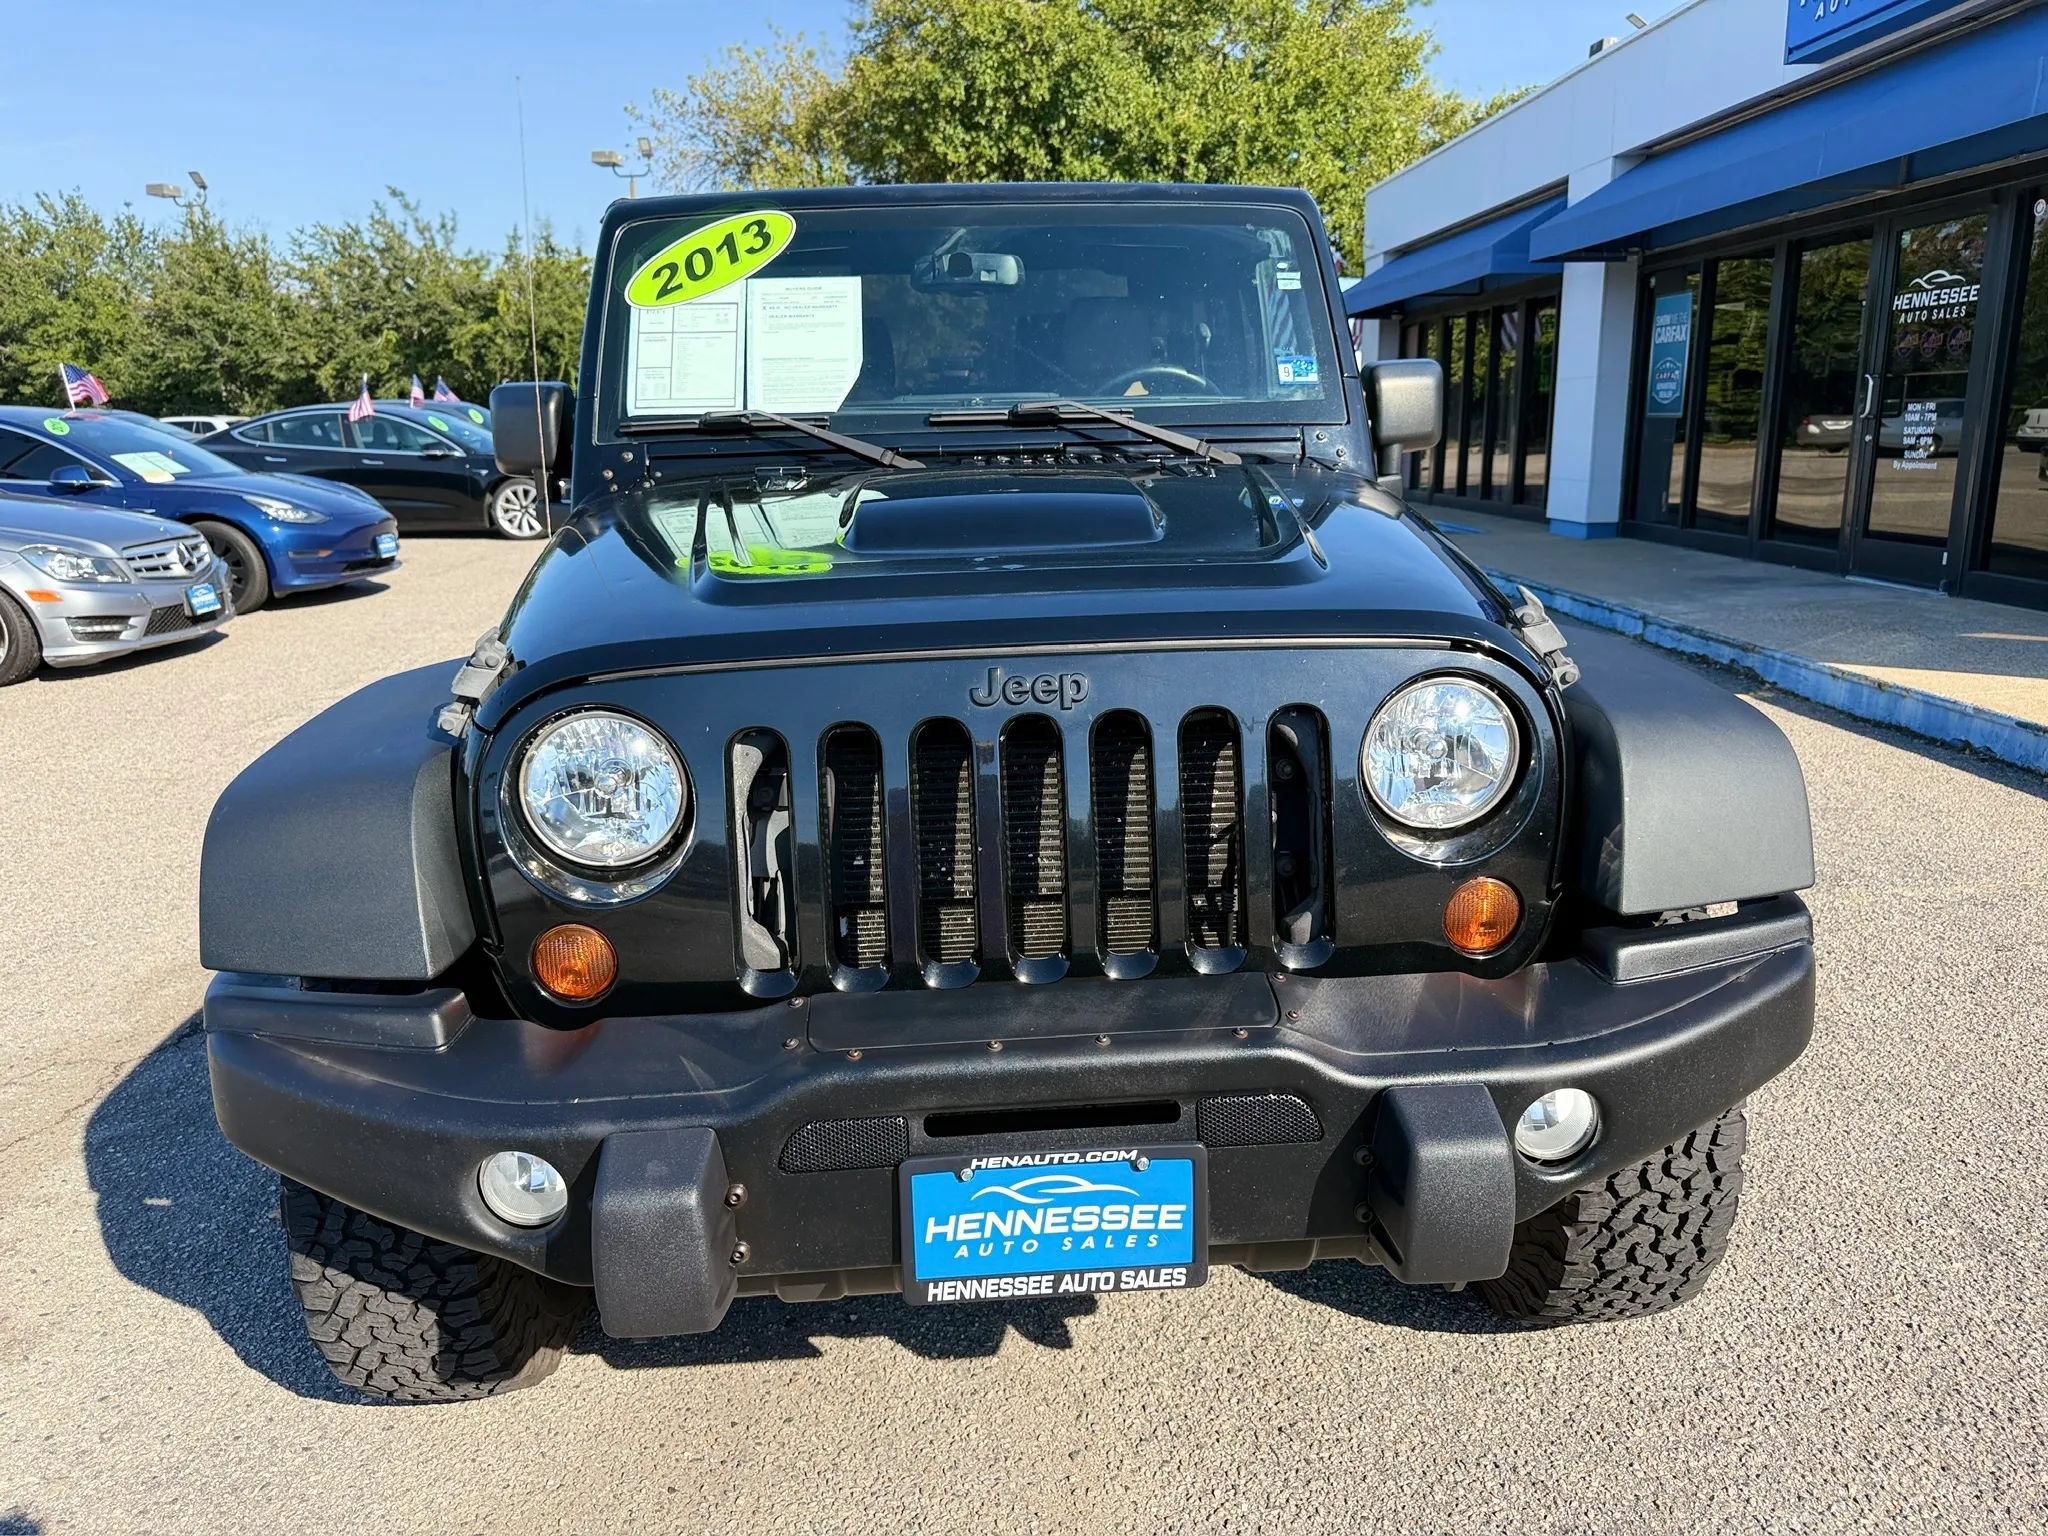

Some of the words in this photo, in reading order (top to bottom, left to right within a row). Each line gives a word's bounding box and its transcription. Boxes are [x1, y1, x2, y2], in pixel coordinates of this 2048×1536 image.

[652, 219, 772, 301] 2013
[1892, 284, 1980, 310] HENNESSEE
[1899, 310, 1928, 324] AUTO
[1931, 305, 1967, 320] SALES
[1655, 325, 1688, 344] CARFAX
[1904, 412, 1920, 421] 10AM
[1924, 412, 1937, 421] 7PM
[1907, 403, 1921, 411] MON
[1925, 402, 1936, 411] FRI
[1903, 426, 1935, 435] SATURDAY
[1904, 449, 1928, 459] SUNDAY
[969, 667, 1090, 710] Jeep
[970, 1149, 1138, 1170] HENAUTO.COM
[925, 1204, 1186, 1244] HENNESSEE
[954, 1240, 1039, 1259] AUTO
[1062, 1234, 1159, 1251] SALES
[927, 1275, 1055, 1302] HENNESSEE
[1058, 1271, 1115, 1293] AUTO
[1120, 1268, 1187, 1289] SALES
